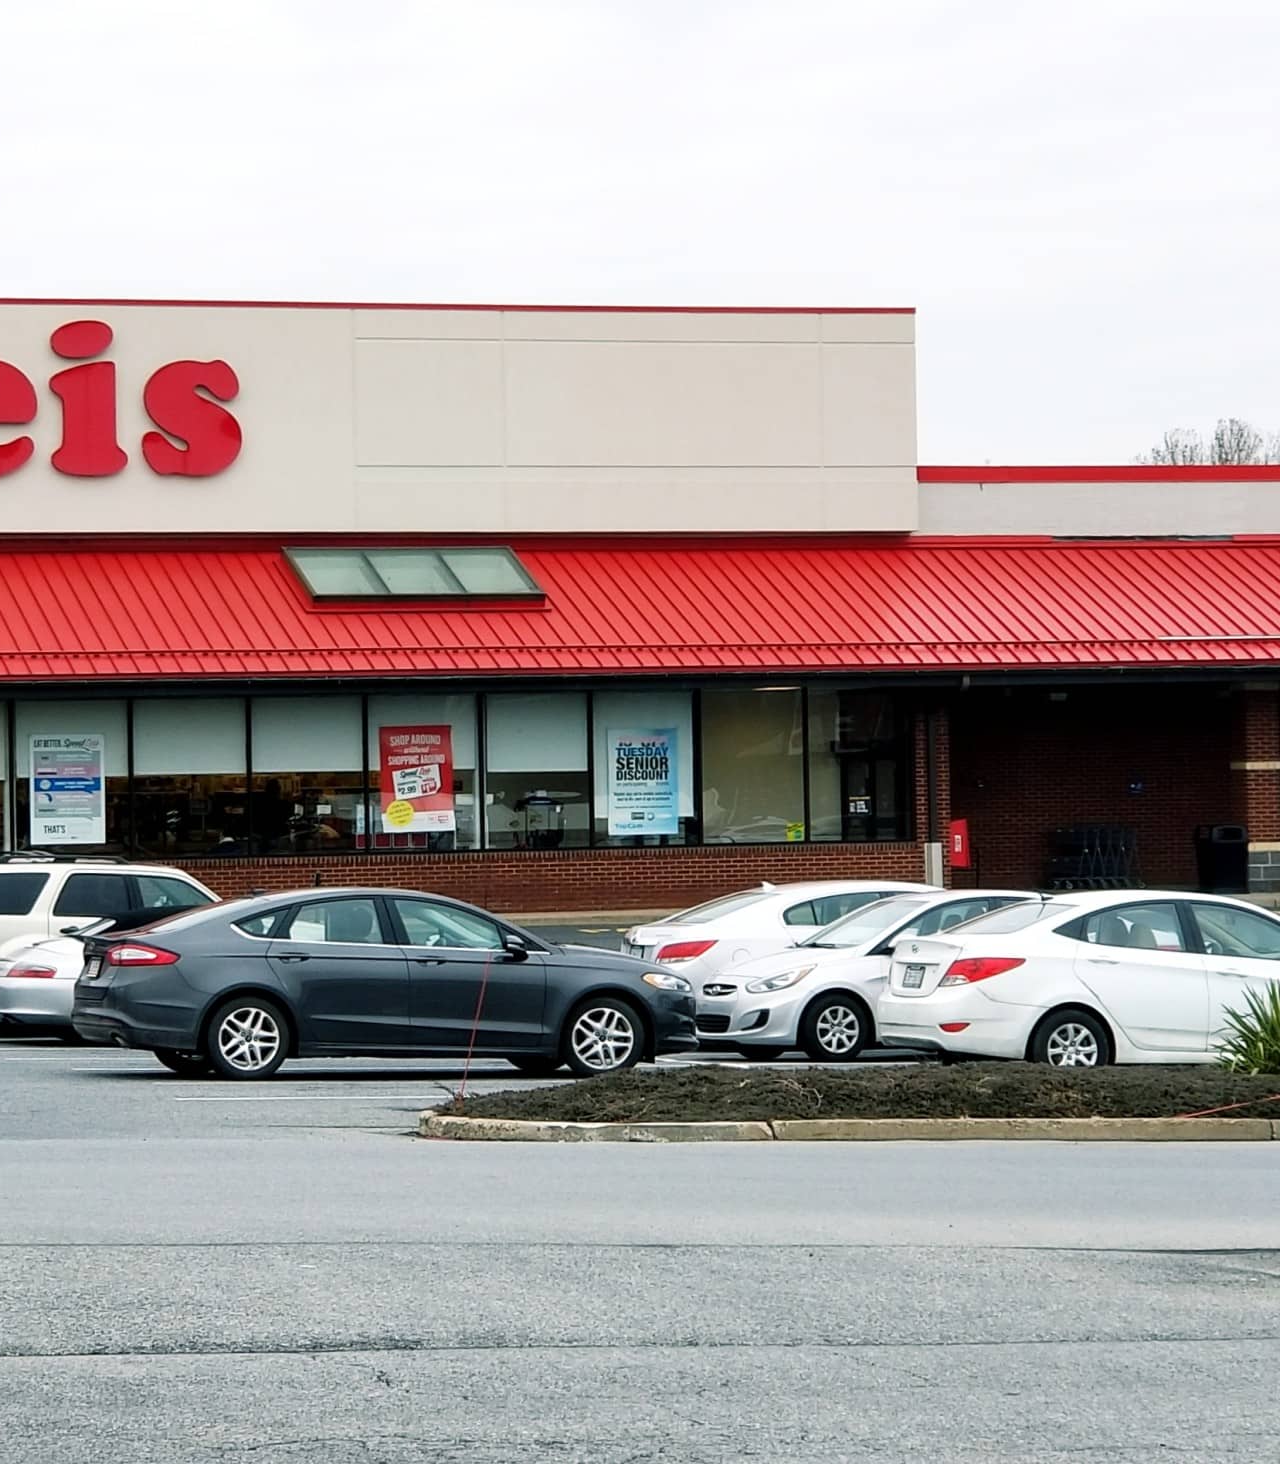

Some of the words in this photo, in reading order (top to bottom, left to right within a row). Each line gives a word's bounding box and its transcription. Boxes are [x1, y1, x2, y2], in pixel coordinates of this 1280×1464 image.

[390, 735, 410, 746] SHOP
[411, 734, 441, 745] AROUND
[615, 747, 669, 757] TUESDAY
[388, 755, 419, 766] SHOPPING
[420, 754, 445, 764] AROUND
[616, 757, 669, 770] SENIOR
[616, 770, 670, 781] DISCOUNT
[43, 824, 66, 834] THAT'S
